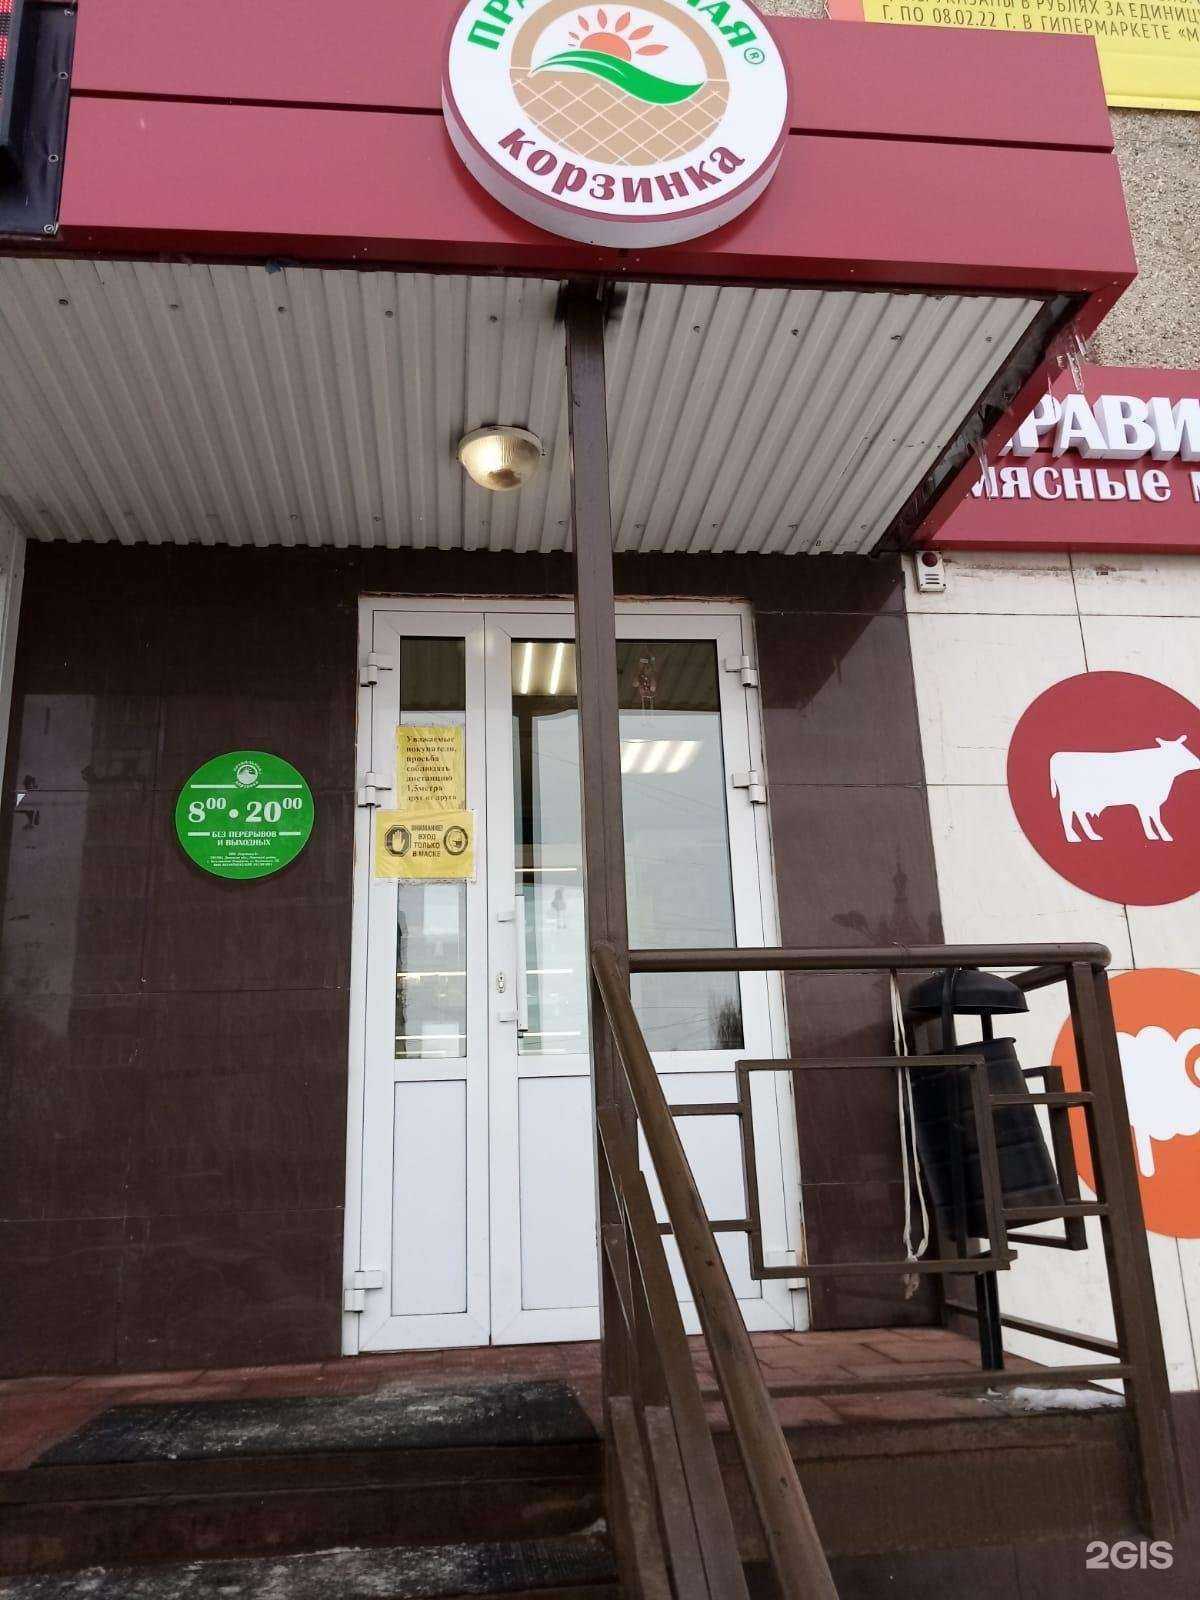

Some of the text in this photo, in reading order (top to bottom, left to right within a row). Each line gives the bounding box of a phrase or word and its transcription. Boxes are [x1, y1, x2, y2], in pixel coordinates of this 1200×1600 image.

[1105, 2, 1125, 16] ЗА
[882, 5, 893, 20] Г.
[900, 6, 924, 22] ПО
[932, 8, 997, 28] 08.02.22
[1005, 13, 1016, 28] Г.
[1023, 14, 1032, 30] В
[1041, 16, 1171, 40] ГИПЕРМАРКЕТЕ
[998, 394, 1200, 462] РАВИ
[414, 841, 441, 849] ТОЛЬКО
[418, 850, 441, 858] МАСКЕ
